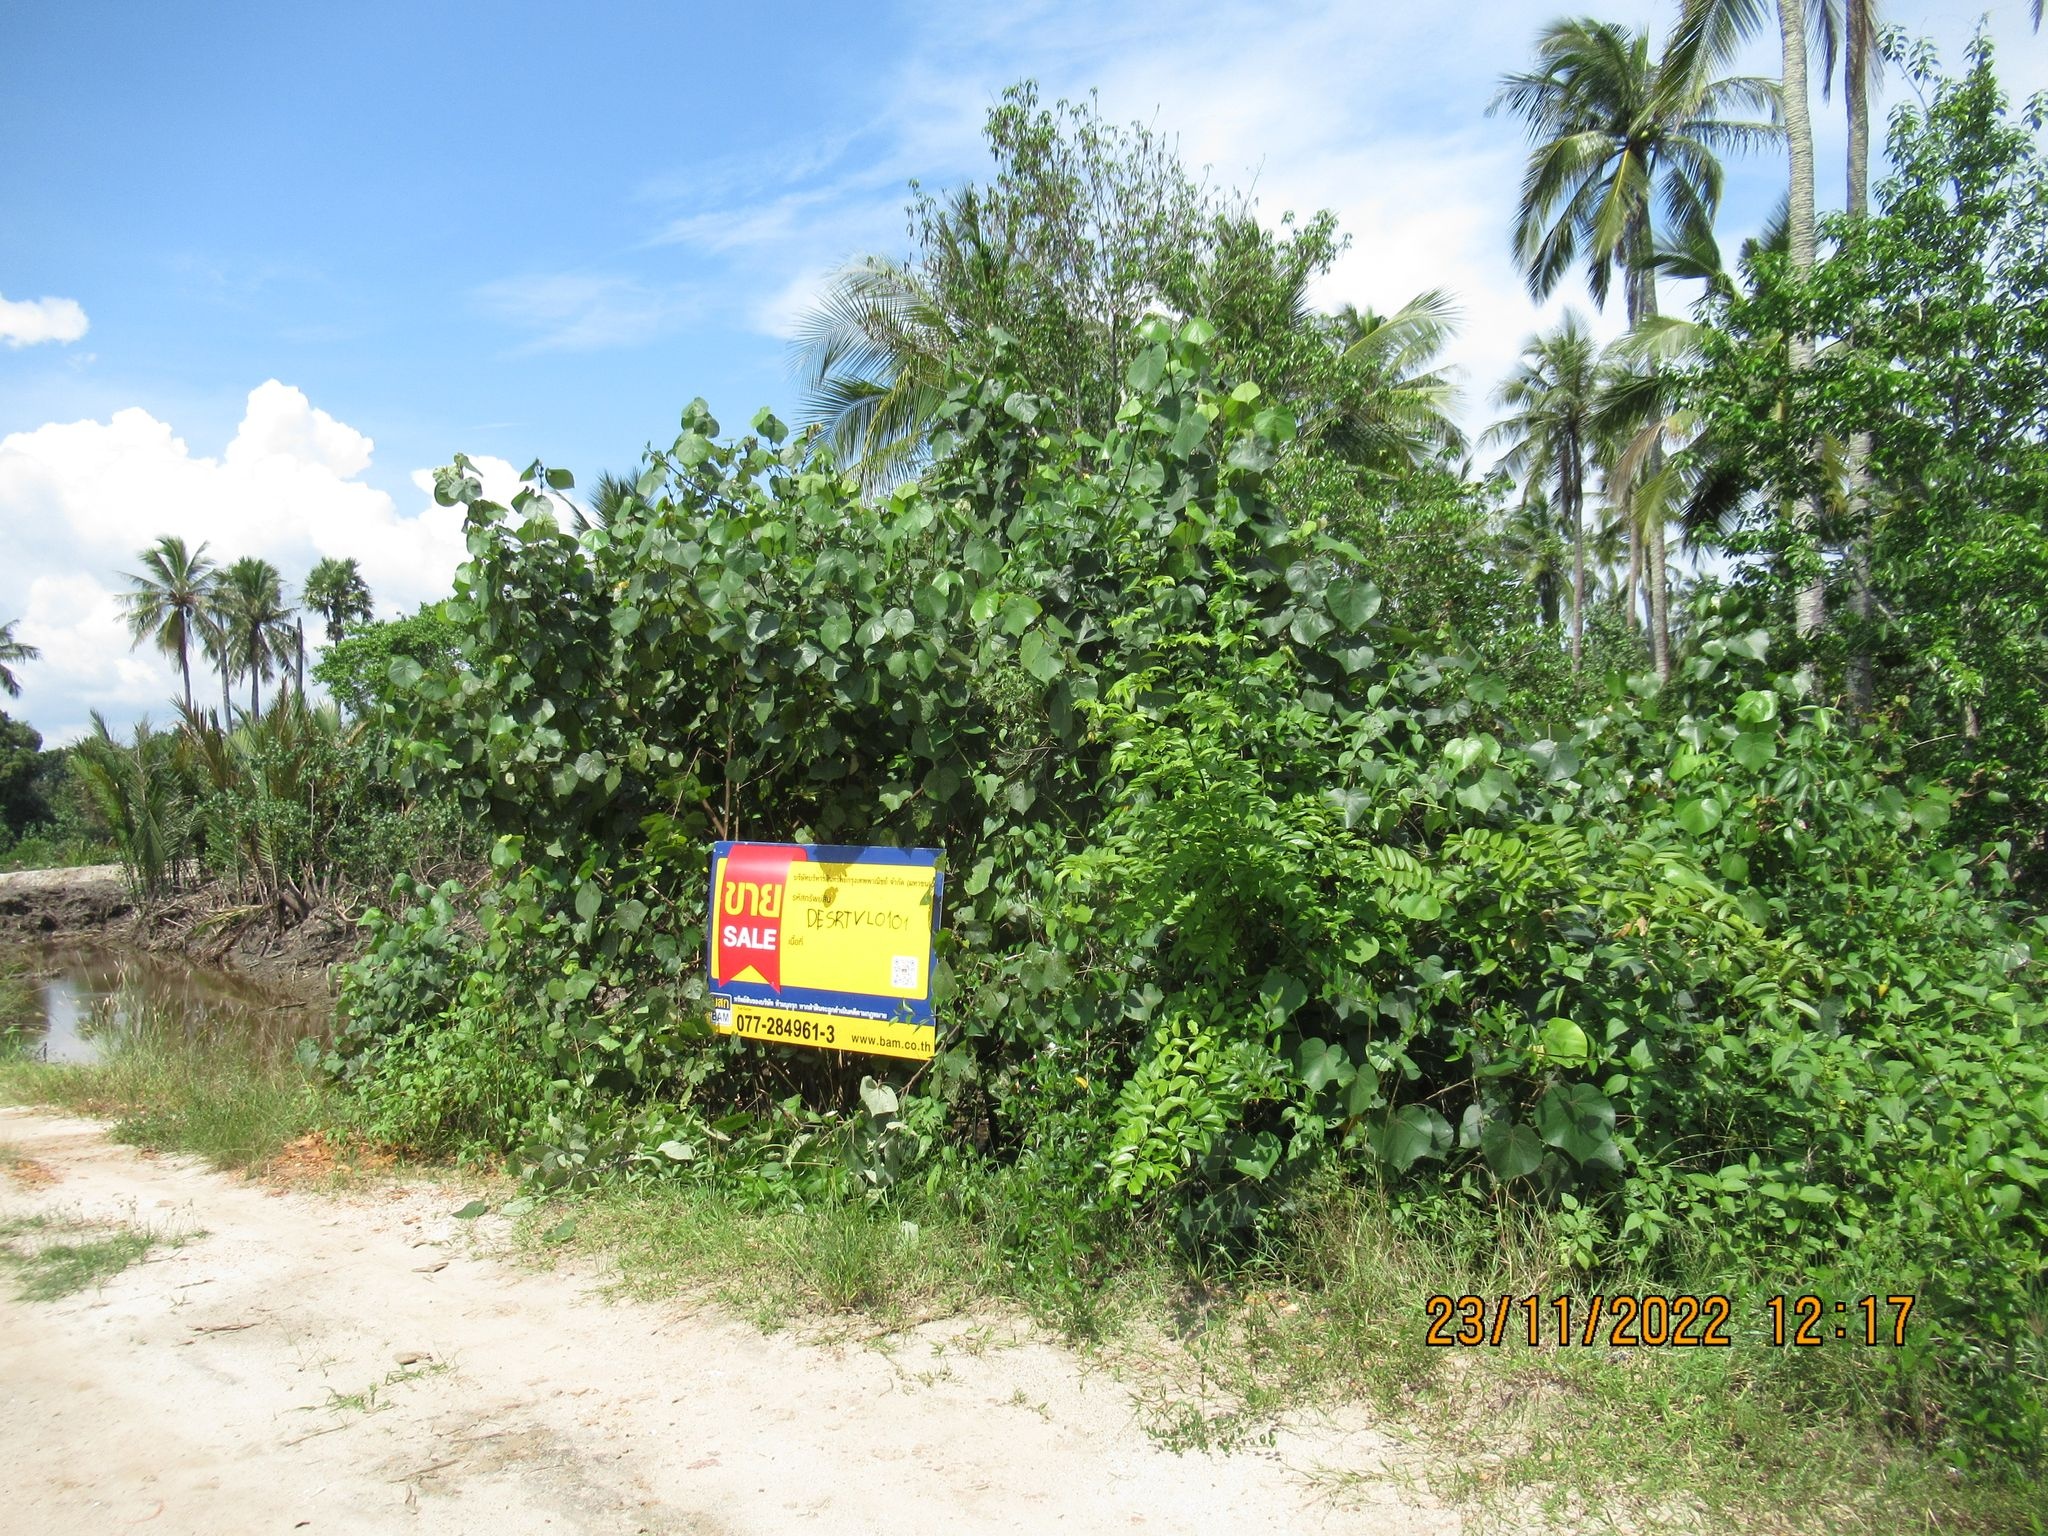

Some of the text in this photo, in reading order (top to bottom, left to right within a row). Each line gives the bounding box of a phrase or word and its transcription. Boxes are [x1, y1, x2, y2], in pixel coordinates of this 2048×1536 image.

[724, 881, 783, 918] ขาย
[723, 925, 777, 950] SALE
[736, 1014, 836, 1044] 077-284961-3
[851, 1034, 932, 1052] www.bam.co.th
